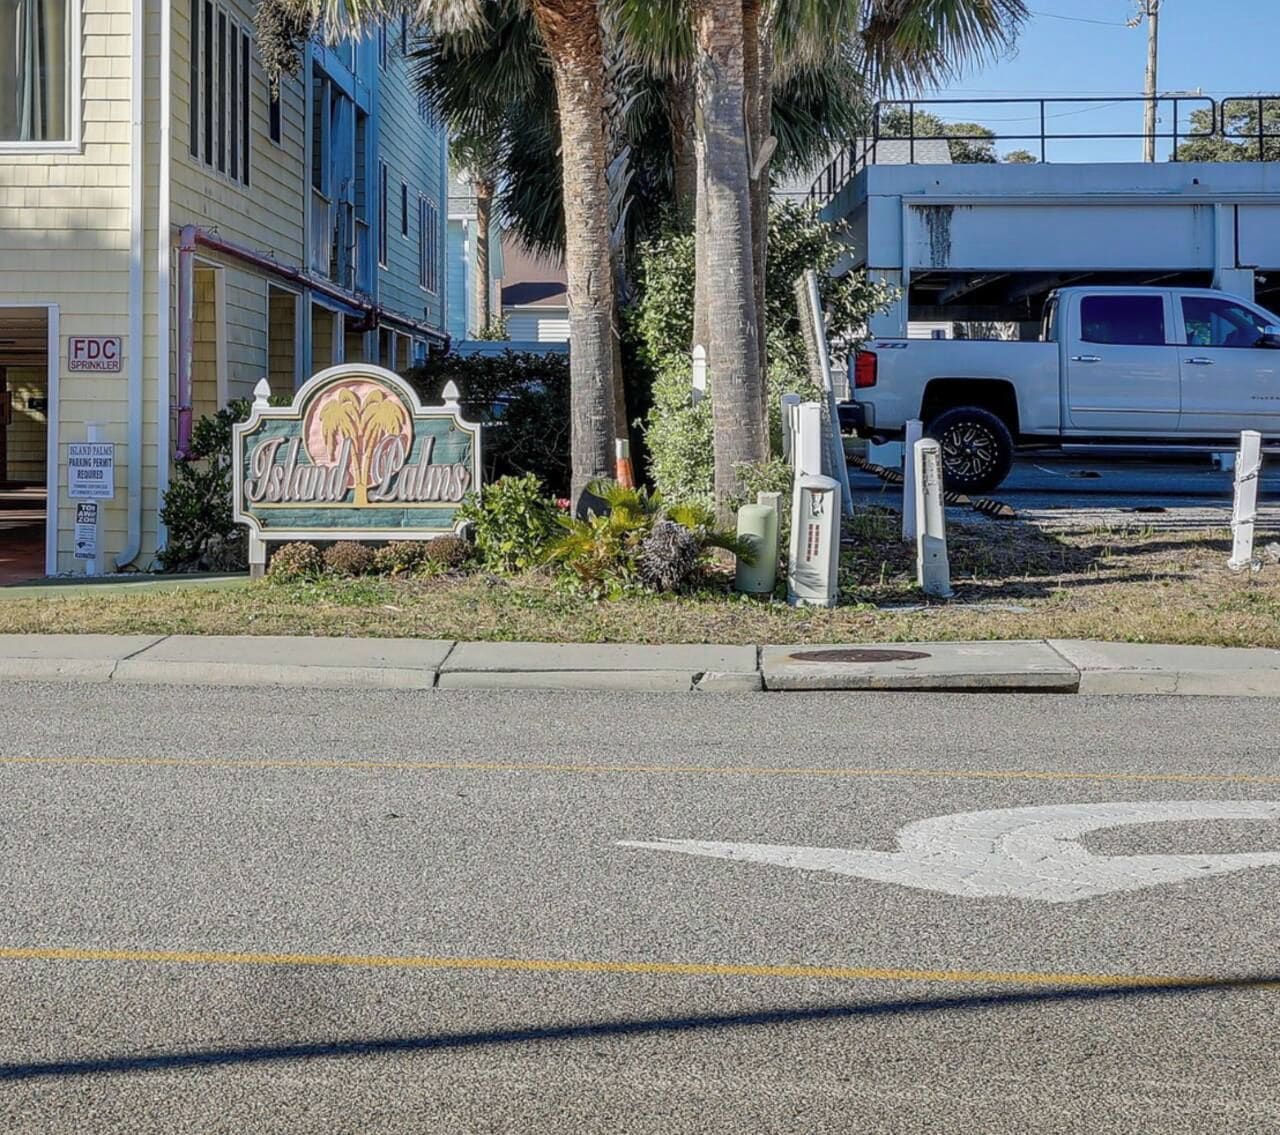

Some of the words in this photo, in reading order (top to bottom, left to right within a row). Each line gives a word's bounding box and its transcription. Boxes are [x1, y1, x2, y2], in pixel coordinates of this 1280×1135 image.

[74, 339, 116, 359] FDC
[71, 360, 119, 370] SPRINKLER
[70, 446, 91, 455] ISLAND
[92, 446, 112, 455] PALMS
[68, 458, 92, 467] PARKING
[93, 458, 112, 467] PERMIT
[244, 436, 353, 502] Island
[368, 434, 470, 502] Palms
[77, 469, 104, 479] REQUIRED
